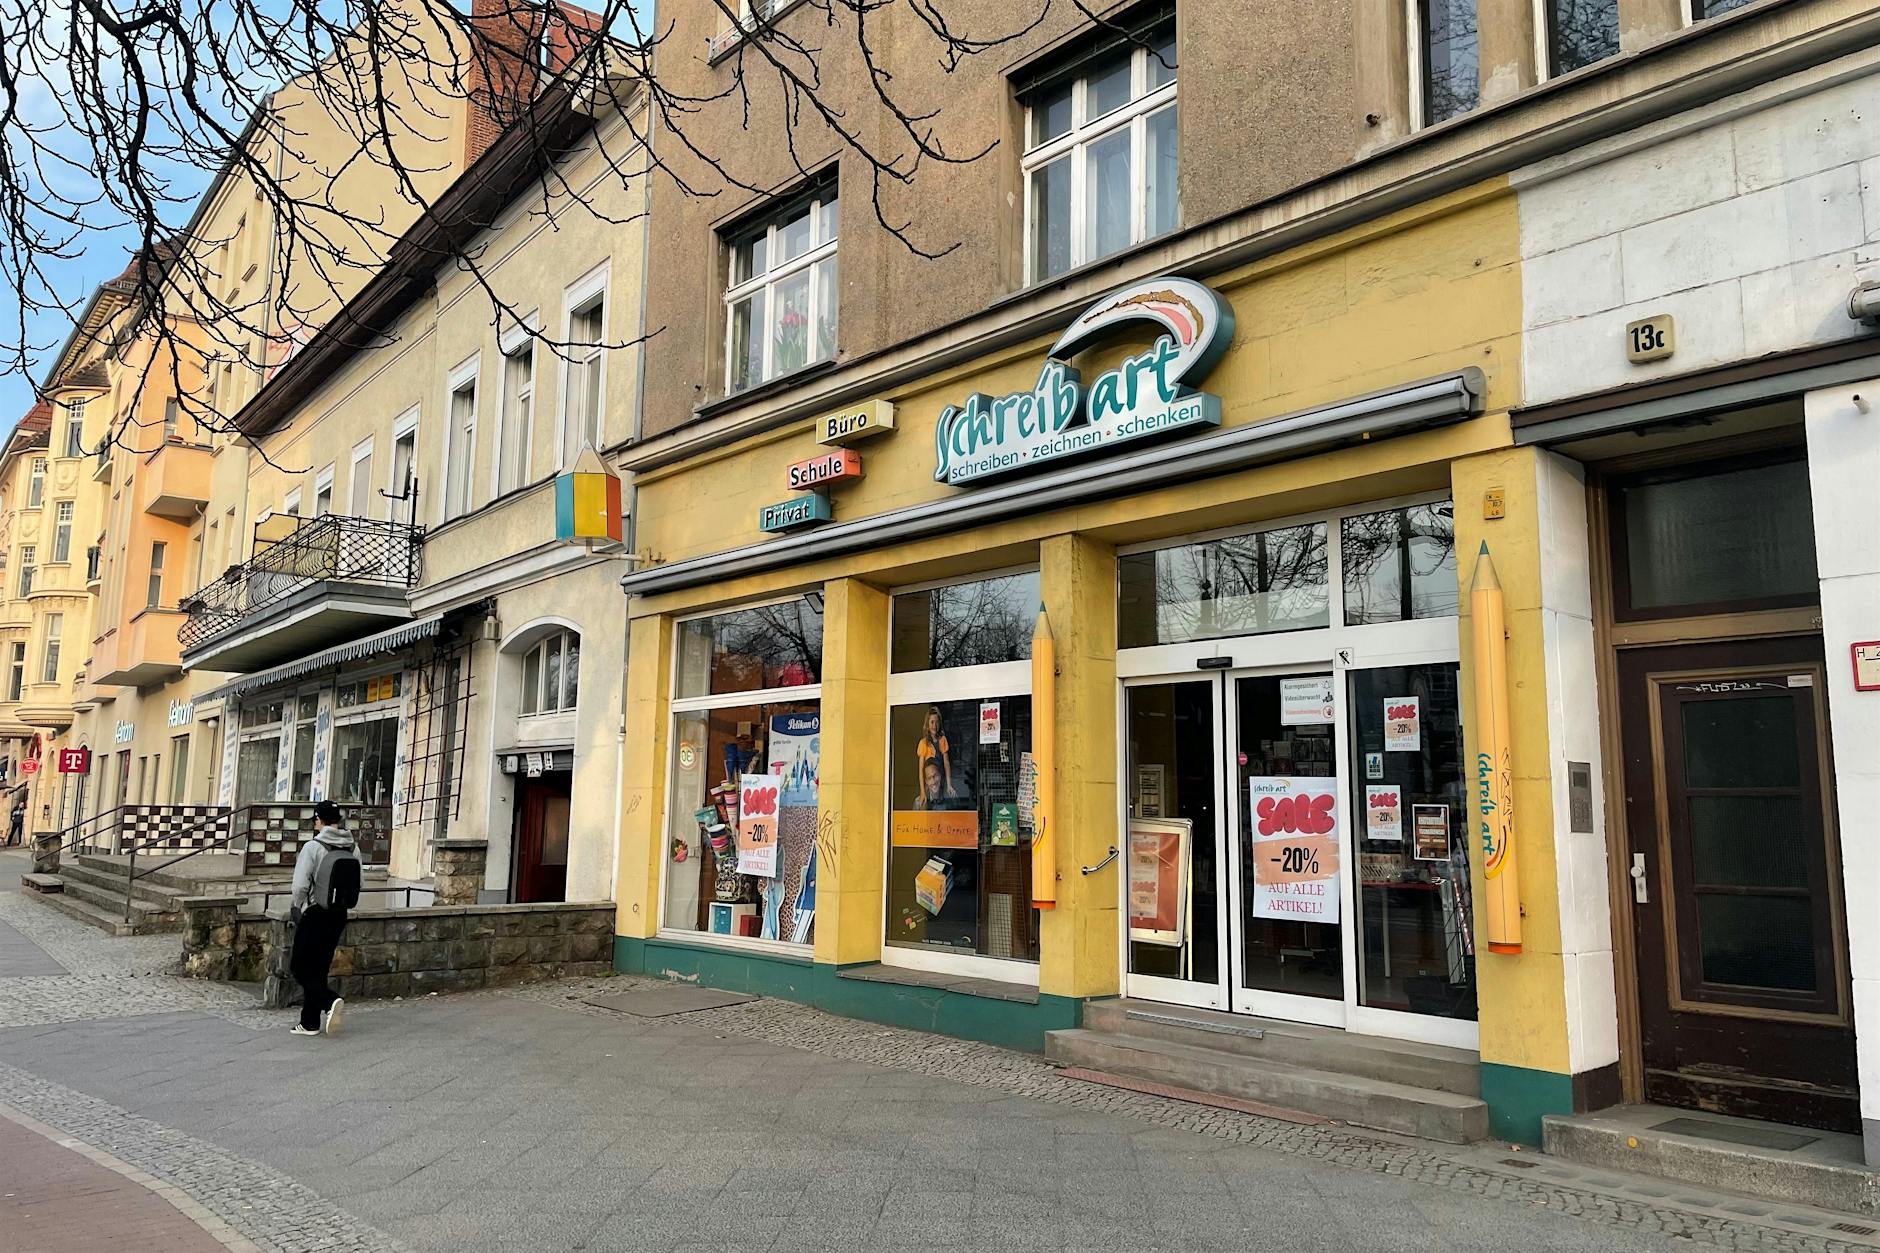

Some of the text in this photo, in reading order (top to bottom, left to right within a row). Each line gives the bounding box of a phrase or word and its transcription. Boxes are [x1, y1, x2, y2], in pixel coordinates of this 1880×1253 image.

[1630, 324, 1665, 352] 13c
[1092, 341, 1180, 421] art
[827, 412, 867, 438] Büro
[951, 402, 1202, 479] schreiben zeichnen schenken
[790, 457, 842, 486] Schule
[764, 500, 810, 528] Privat
[1857, 648, 1865, 658] H
[787, 718, 812, 730] Pelikan
[1387, 704, 1416, 721] SALE
[1393, 723, 1411, 734] -20%
[65, 752, 82, 770] T
[743, 786, 778, 816] SALE
[1370, 792, 1398, 809] SALE
[1256, 793, 1335, 836] SALE
[1375, 812, 1394, 823] -20%
[747, 823, 769, 843] -20%
[1481, 821, 1496, 856] art
[1270, 847, 1319, 874] -20%
[1268, 882, 1325, 896] AUF ALLE
[1267, 899, 1323, 914] ARTIKEL!
